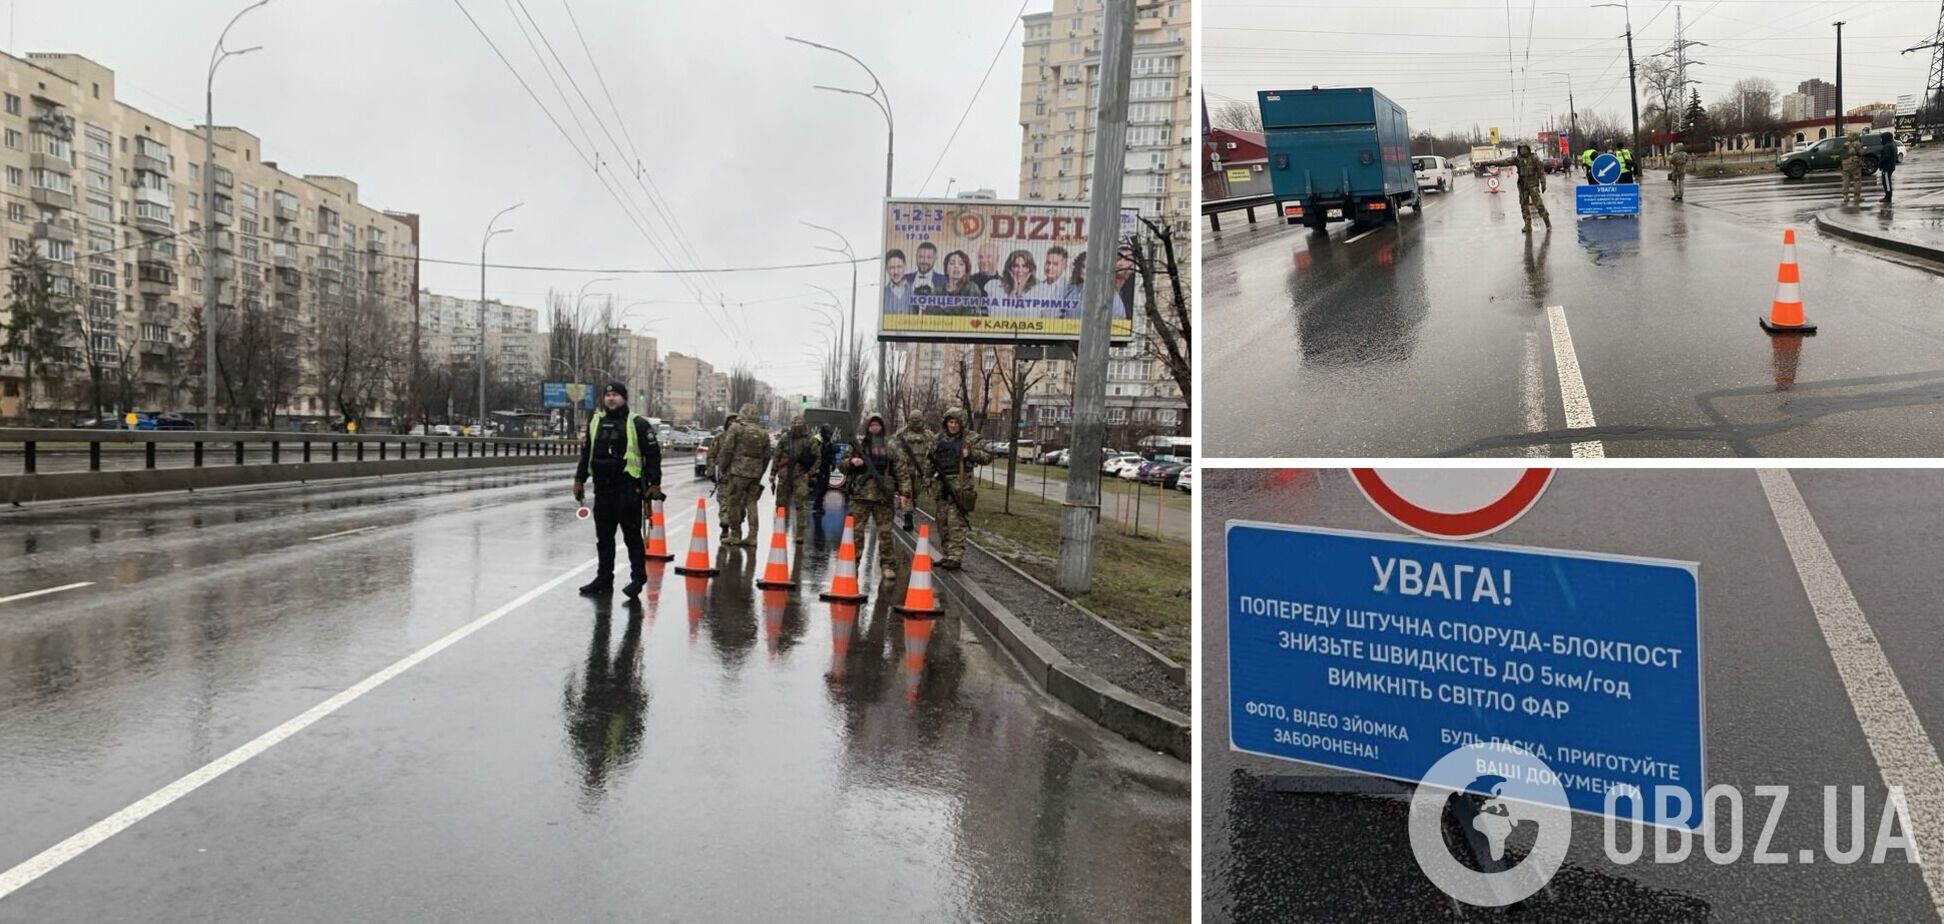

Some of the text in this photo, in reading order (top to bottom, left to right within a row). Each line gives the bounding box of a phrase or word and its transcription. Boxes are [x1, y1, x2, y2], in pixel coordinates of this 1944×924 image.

[910, 295, 1080, 309] КОНЦЕРТИ НА ПІДТРИМКУ
[984, 320, 1043, 330] KARABAS
[1371, 556, 1512, 606] УВАГА!
[1240, 596, 1682, 669] ПОПЕРЕДУ ШТУЧНА СПОРУДА-БЛОКПОСТ
[1278, 631, 1631, 699] ЗНИЗЬТЕ ШВИДКІСТЬ ДО 5км/год
[1328, 667, 1570, 719] ВИМКНІТЬ СВІТЛО ФАР
[1245, 701, 1409, 741] ФОТО, ВІДЕО ЗЙОМКА
[1274, 728, 1379, 760] ЗАБОРОНЕНА!
[1441, 729, 1680, 781] БУДЬ ЛАСКА, ПРИГОТУЙТЕ
[1476, 759, 1641, 799] ВАШІ ДОКУМЕНТИ
